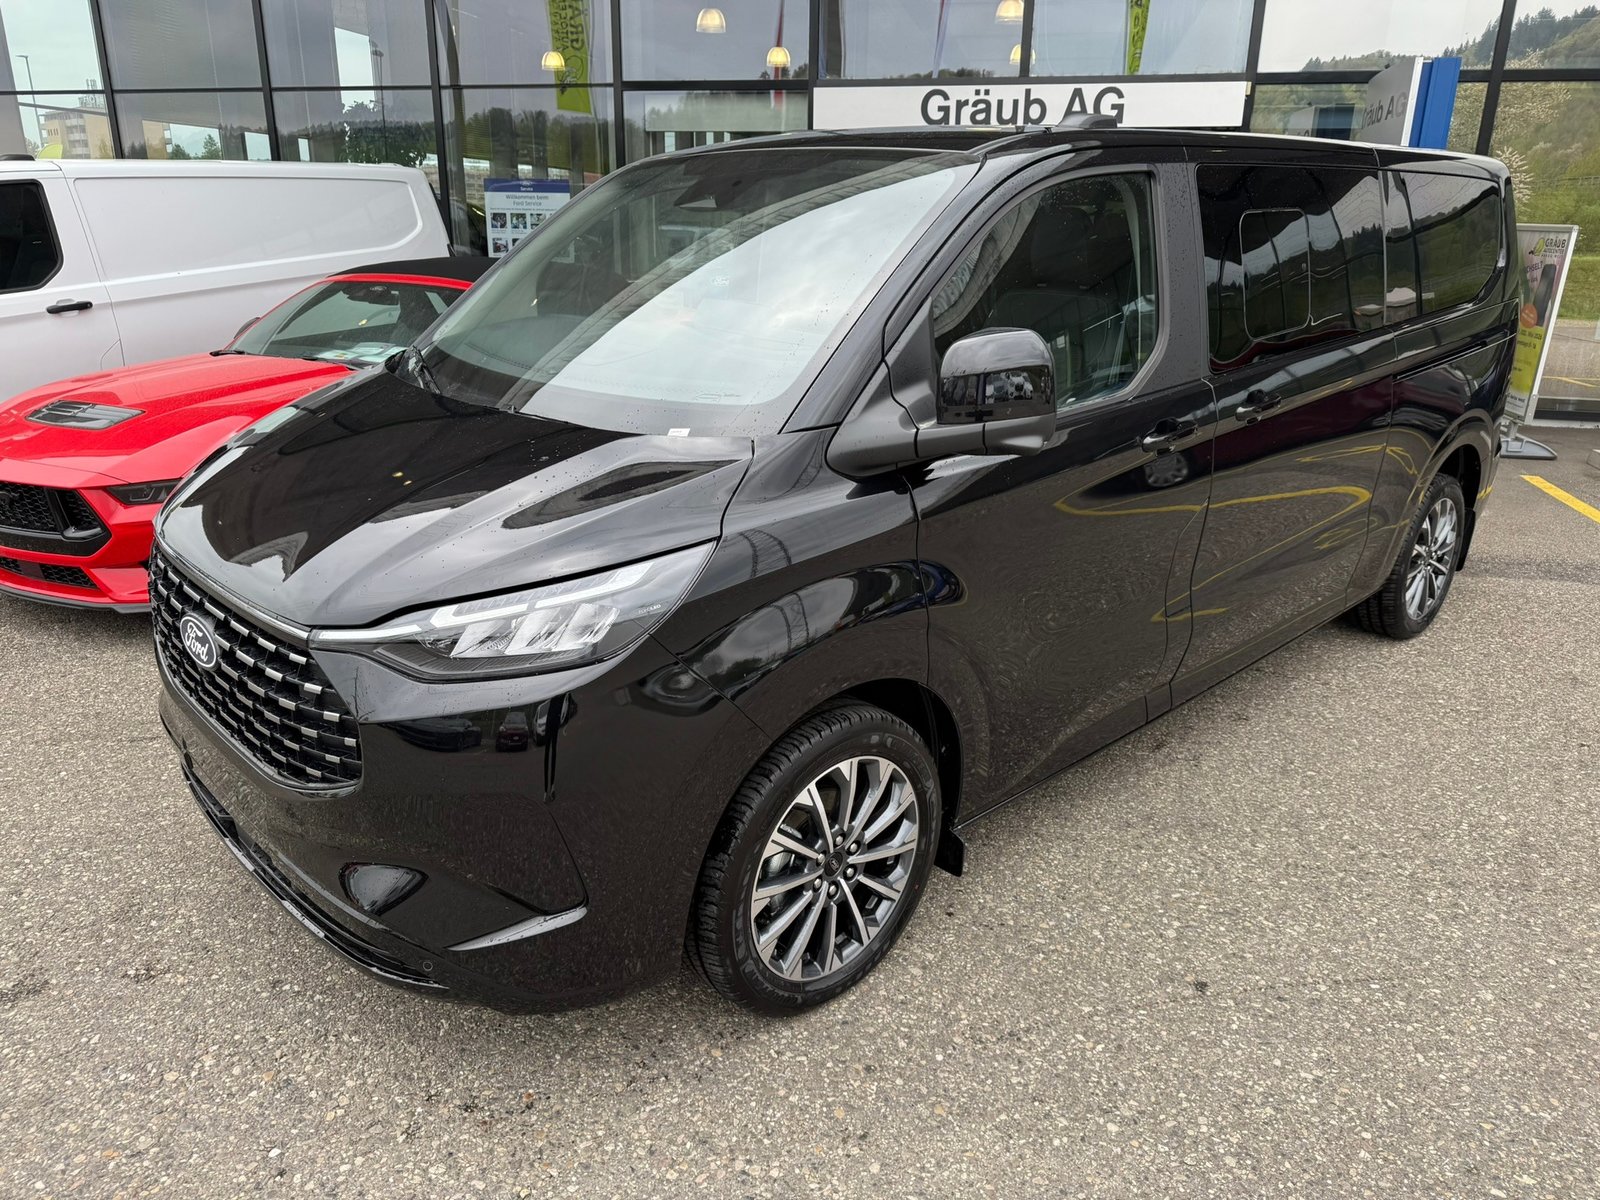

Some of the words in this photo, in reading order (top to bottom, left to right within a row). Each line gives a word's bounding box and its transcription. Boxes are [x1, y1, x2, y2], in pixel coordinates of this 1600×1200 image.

[920, 88, 1047, 126] Gräub
[1058, 86, 1125, 125] AG
[1545, 236, 1566, 248] GRÄUB
[185, 622, 209, 662] Ford
